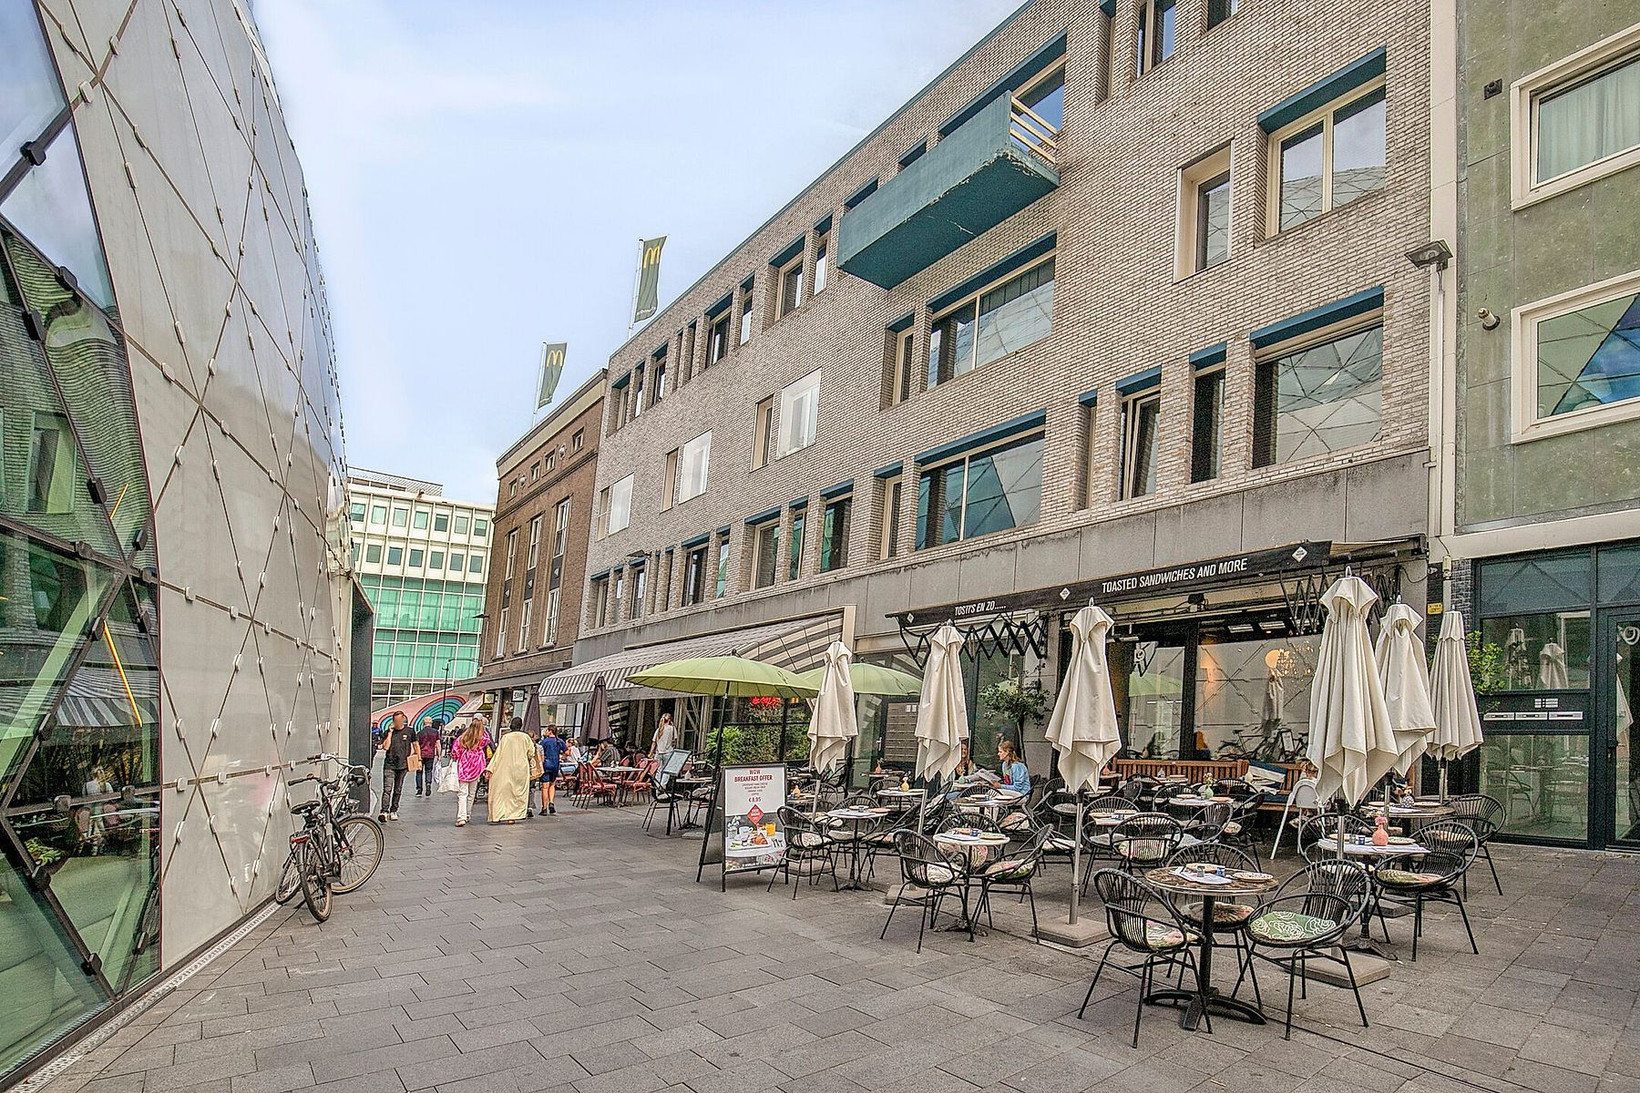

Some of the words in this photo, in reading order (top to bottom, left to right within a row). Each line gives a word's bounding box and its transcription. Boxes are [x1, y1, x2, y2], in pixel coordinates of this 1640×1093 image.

[1102, 577, 1138, 593] TOASTED
[1139, 567, 1196, 588] SANDWICHES
[1197, 563, 1216, 578] AND
[1218, 558, 1248, 574] MORE
[976, 602, 986, 613] EN
